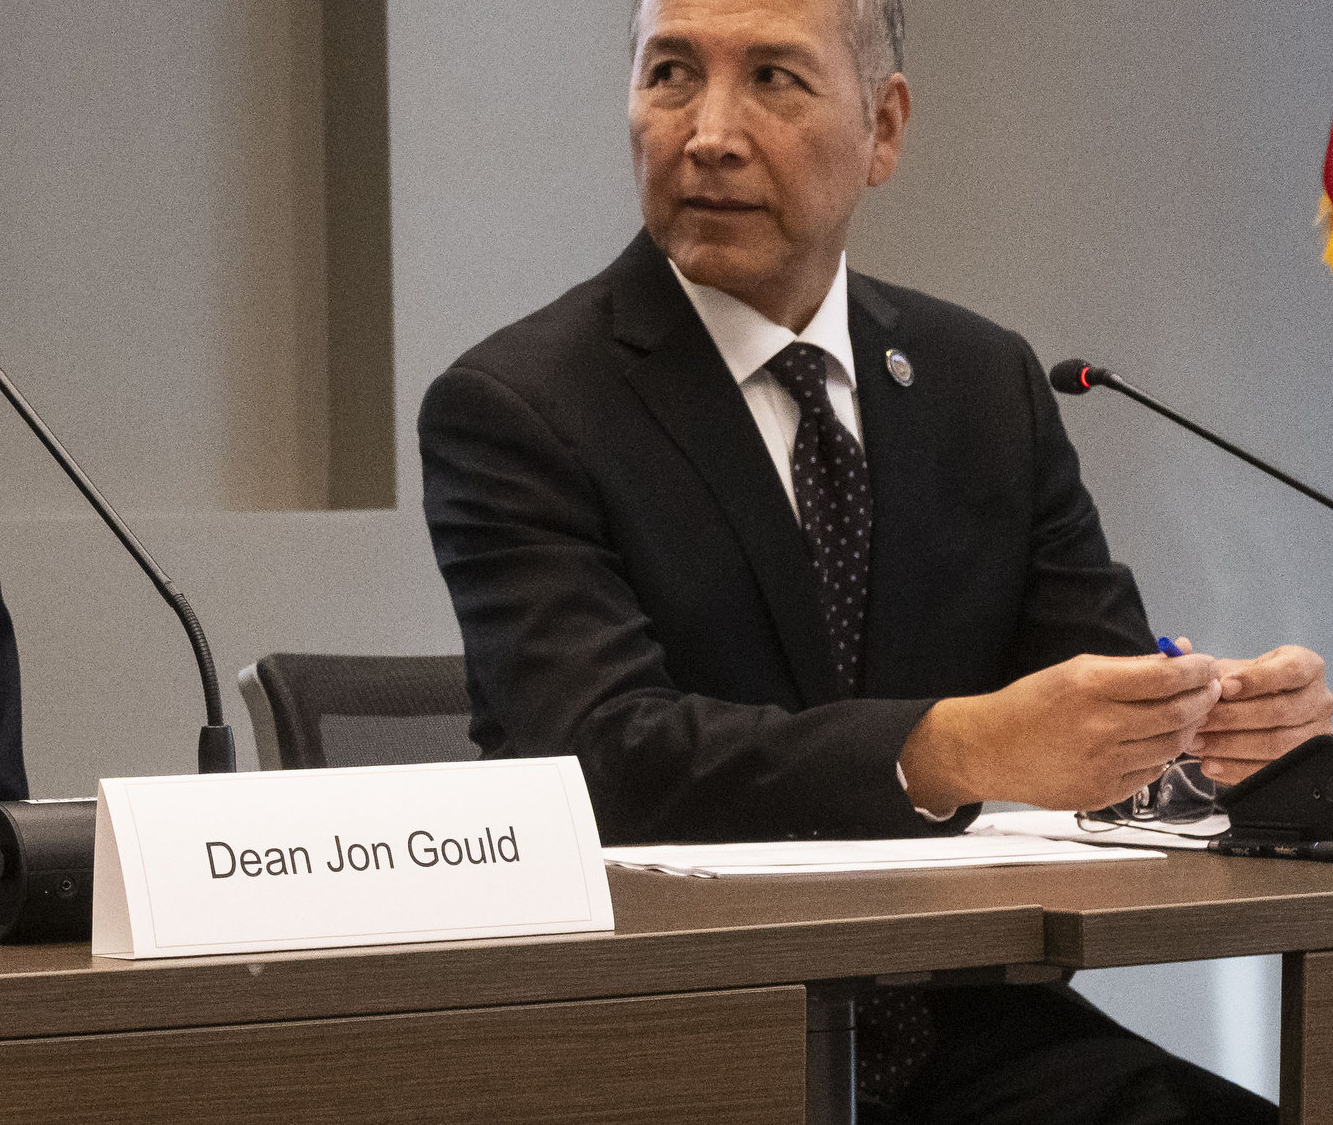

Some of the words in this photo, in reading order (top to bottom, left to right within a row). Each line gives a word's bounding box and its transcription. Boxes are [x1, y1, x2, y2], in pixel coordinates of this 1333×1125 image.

[205, 840, 312, 880] Dean
[326, 834, 395, 874] Jon
[406, 825, 520, 868] Gould
